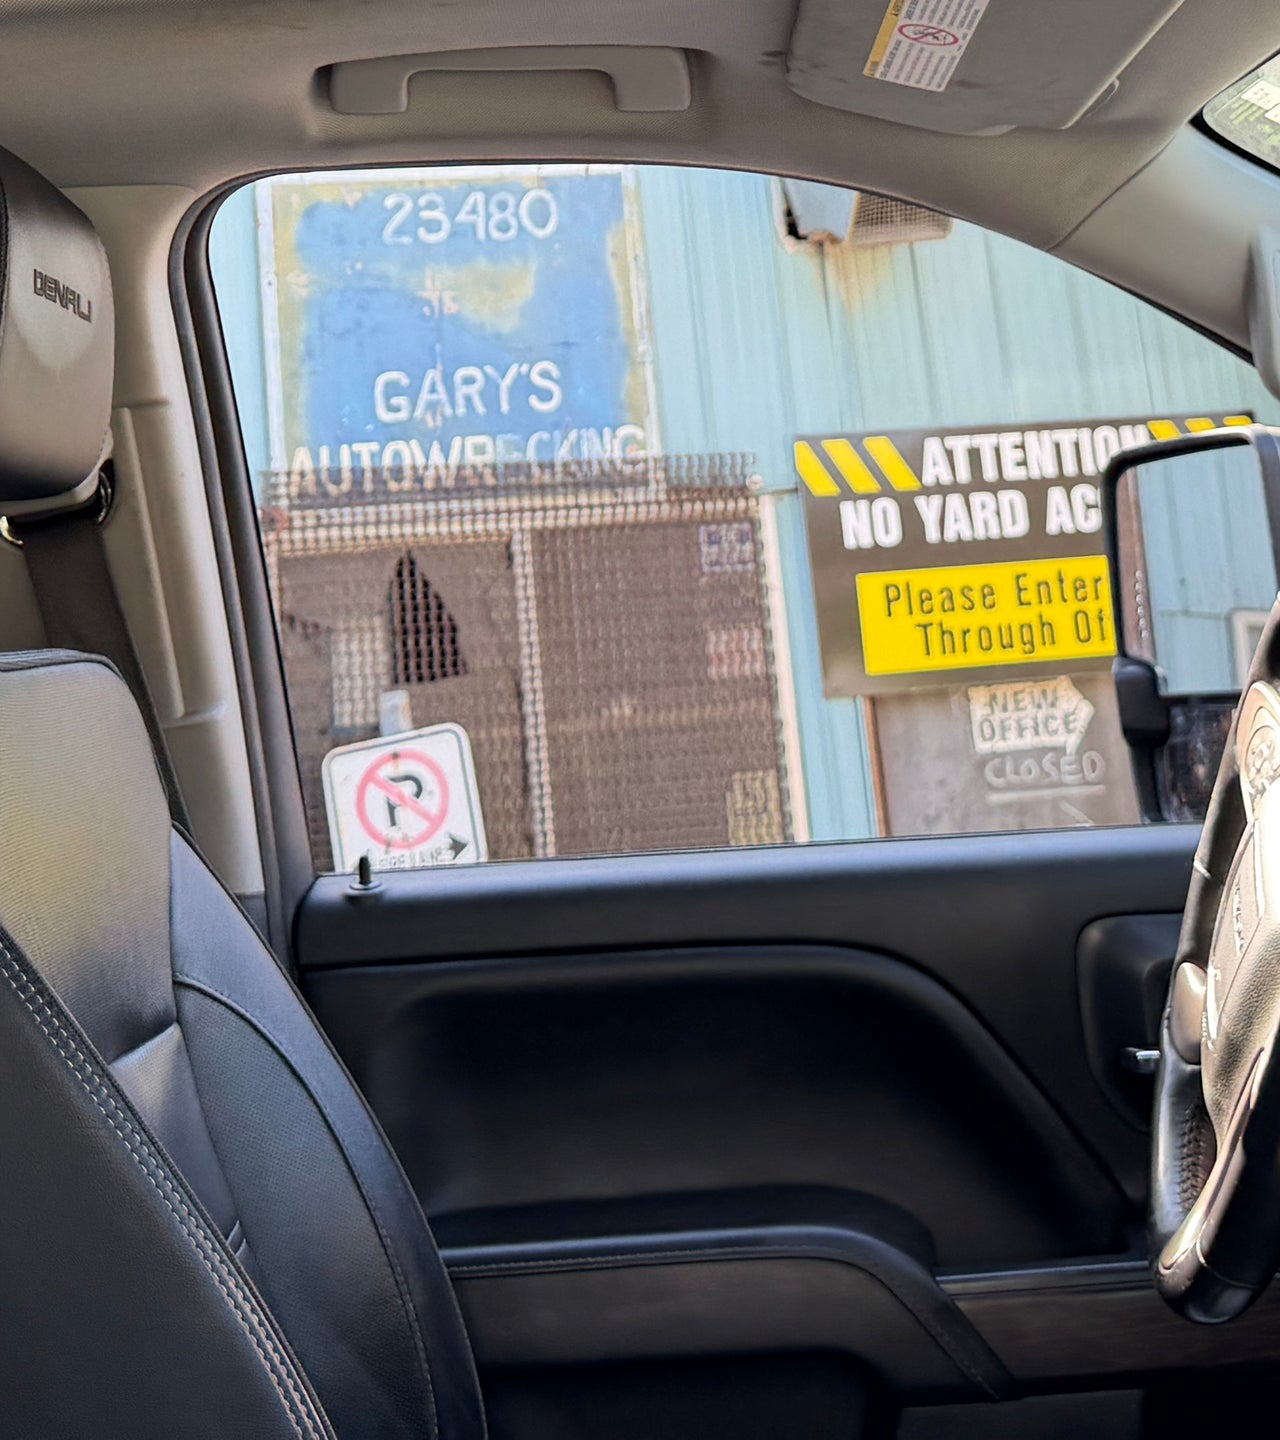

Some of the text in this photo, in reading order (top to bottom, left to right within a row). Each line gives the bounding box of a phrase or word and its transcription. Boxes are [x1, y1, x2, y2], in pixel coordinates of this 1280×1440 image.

[381, 188, 558, 245] 23480
[34, 268, 92, 323] DENALI
[374, 361, 562, 423] GARY'S
[839, 484, 1103, 550] NO YARD AC
[885, 570, 1105, 618] Please Enter
[916, 610, 1108, 656] Through Of
[988, 688, 1058, 715] NEW
[979, 712, 1077, 742] OFFICE
[984, 751, 1106, 788] CLOSED
